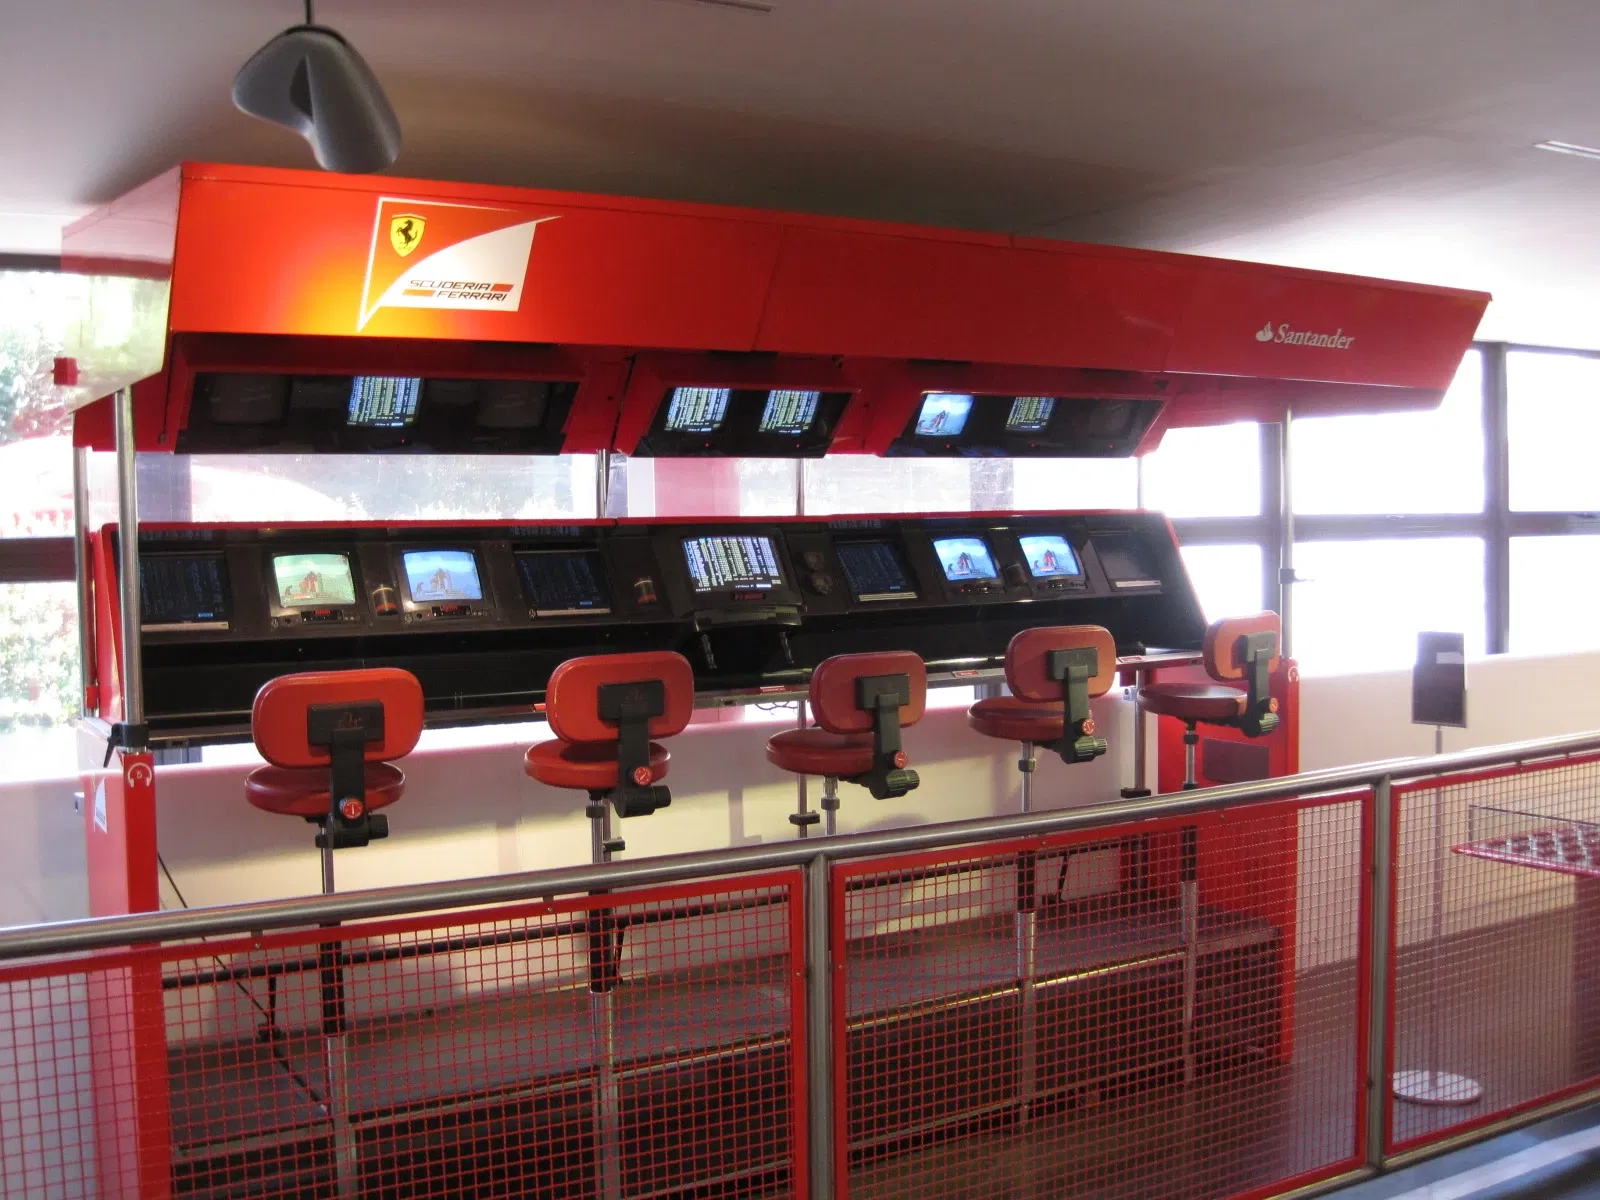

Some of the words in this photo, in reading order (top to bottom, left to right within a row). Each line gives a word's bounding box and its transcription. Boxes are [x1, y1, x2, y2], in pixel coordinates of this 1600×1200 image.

[409, 279, 491, 291] SCUDERIA
[437, 290, 507, 301] FERRARI
[1274, 324, 1354, 349] Santander
